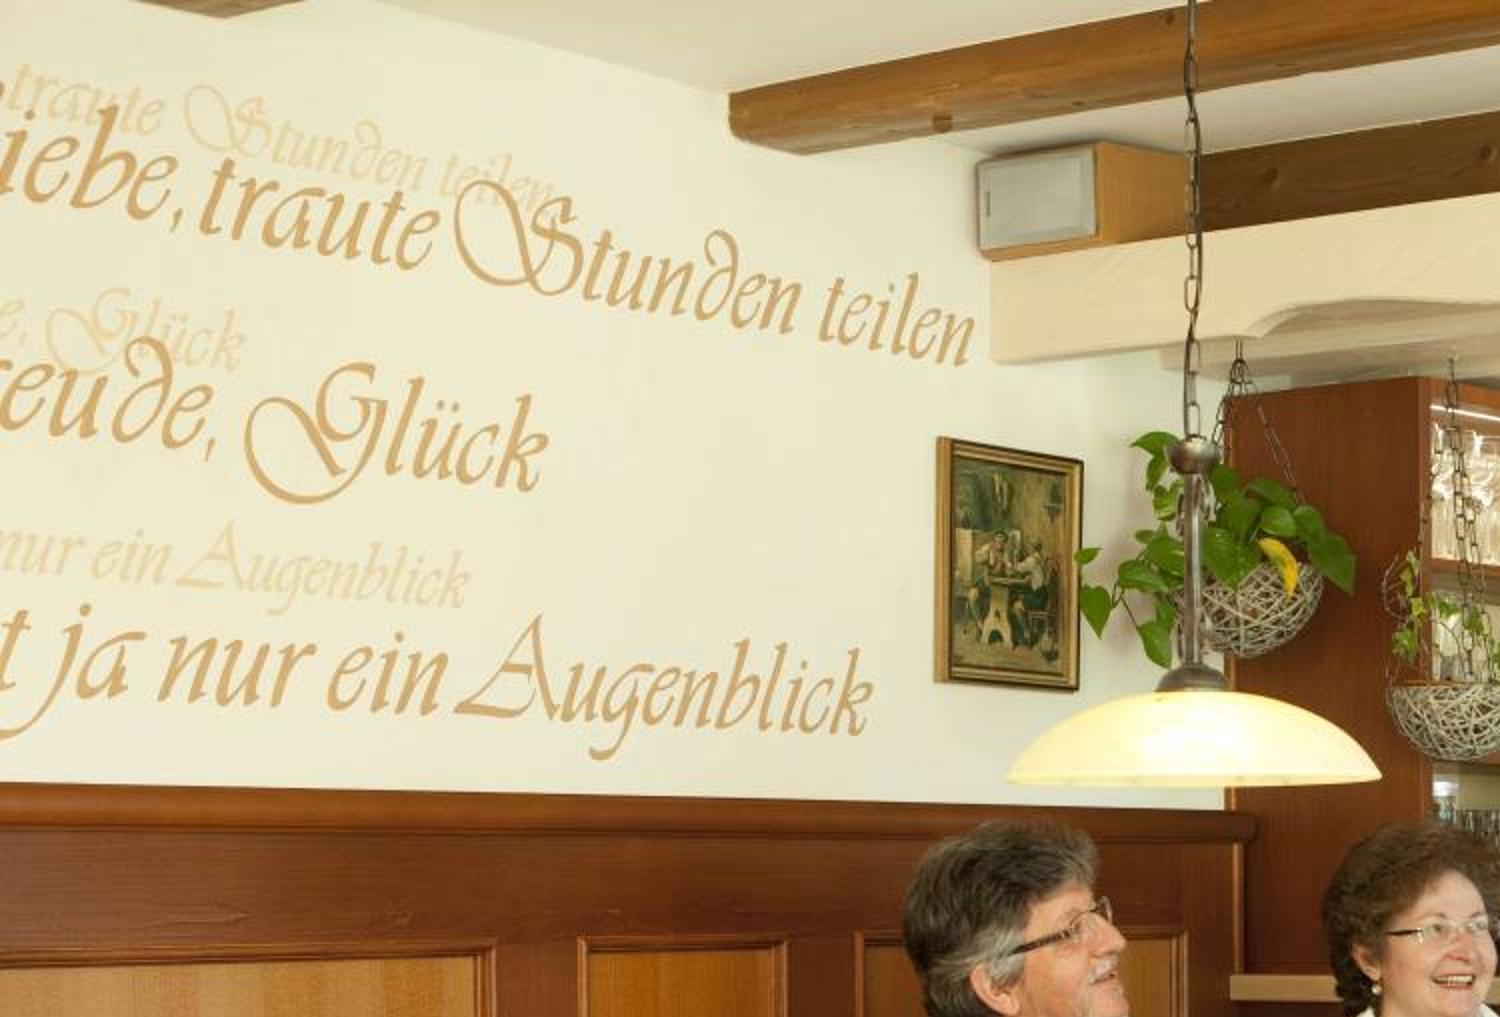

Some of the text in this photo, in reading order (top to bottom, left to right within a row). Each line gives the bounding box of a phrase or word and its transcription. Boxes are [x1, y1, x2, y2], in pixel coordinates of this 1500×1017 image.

[7, 64, 165, 135] traute
[184, 84, 428, 191] Stunden
[0, 100, 975, 366] iebe, traute Stunden teilen
[46, 287, 247, 373] Glück
[0, 335, 550, 504] eude, Glück
[92, 528, 172, 583] ein
[175, 520, 472, 615] Augenblick
[0, 602, 147, 741] ja
[156, 635, 317, 708] nur
[327, 631, 449, 716] ein
[453, 611, 876, 762] Augenblick
